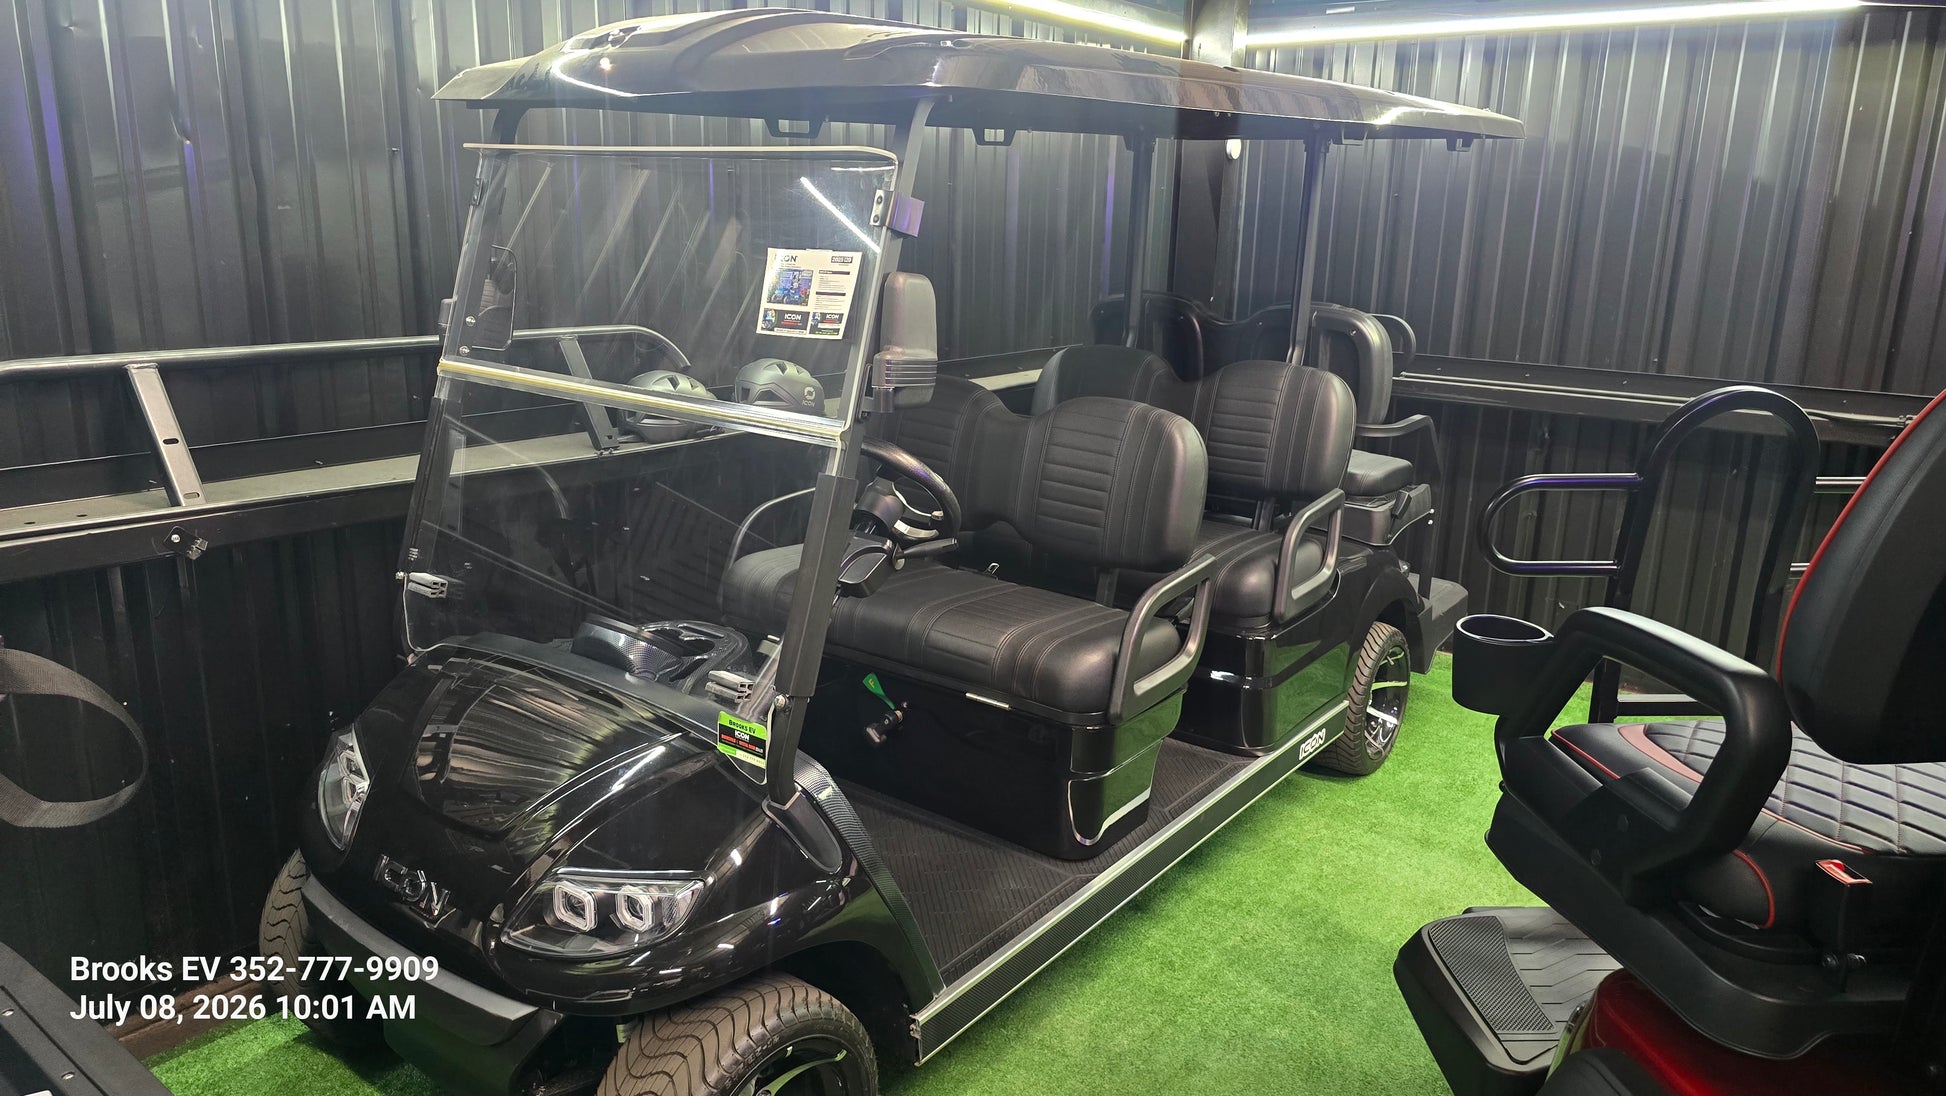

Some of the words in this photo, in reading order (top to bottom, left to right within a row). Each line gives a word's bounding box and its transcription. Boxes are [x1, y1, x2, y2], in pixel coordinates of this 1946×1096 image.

[784, 313, 801, 321] ICON
[734, 729, 750, 742] ICON
[1299, 727, 1326, 760] ICON
[373, 854, 450, 915] ICON
